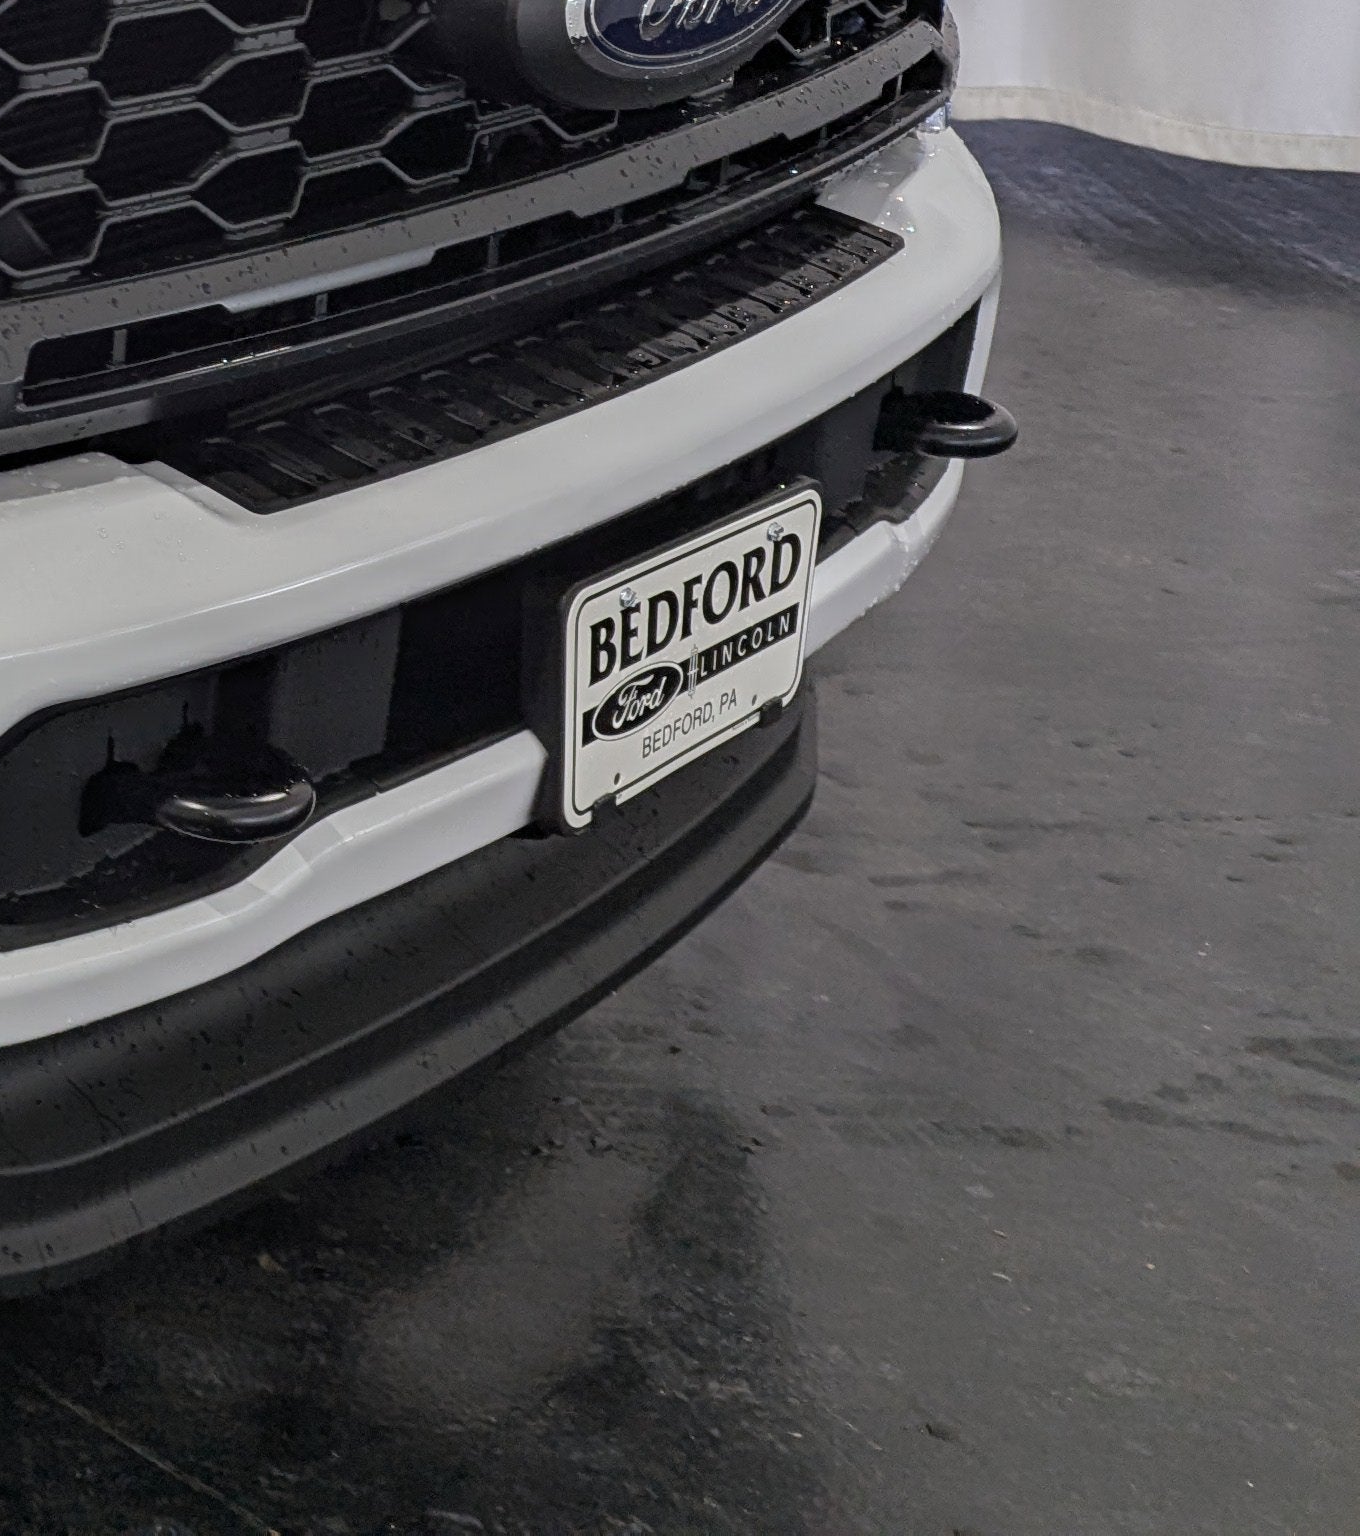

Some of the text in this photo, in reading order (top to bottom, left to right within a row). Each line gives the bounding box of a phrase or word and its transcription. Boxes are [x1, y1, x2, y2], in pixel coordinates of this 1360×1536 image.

[589, 533, 802, 687] BEDFORD
[700, 613, 791, 677] LINCOLN
[612, 674, 666, 729] Ford
[642, 702, 715, 758] BEDFORD,
[720, 688, 737, 714] PA
